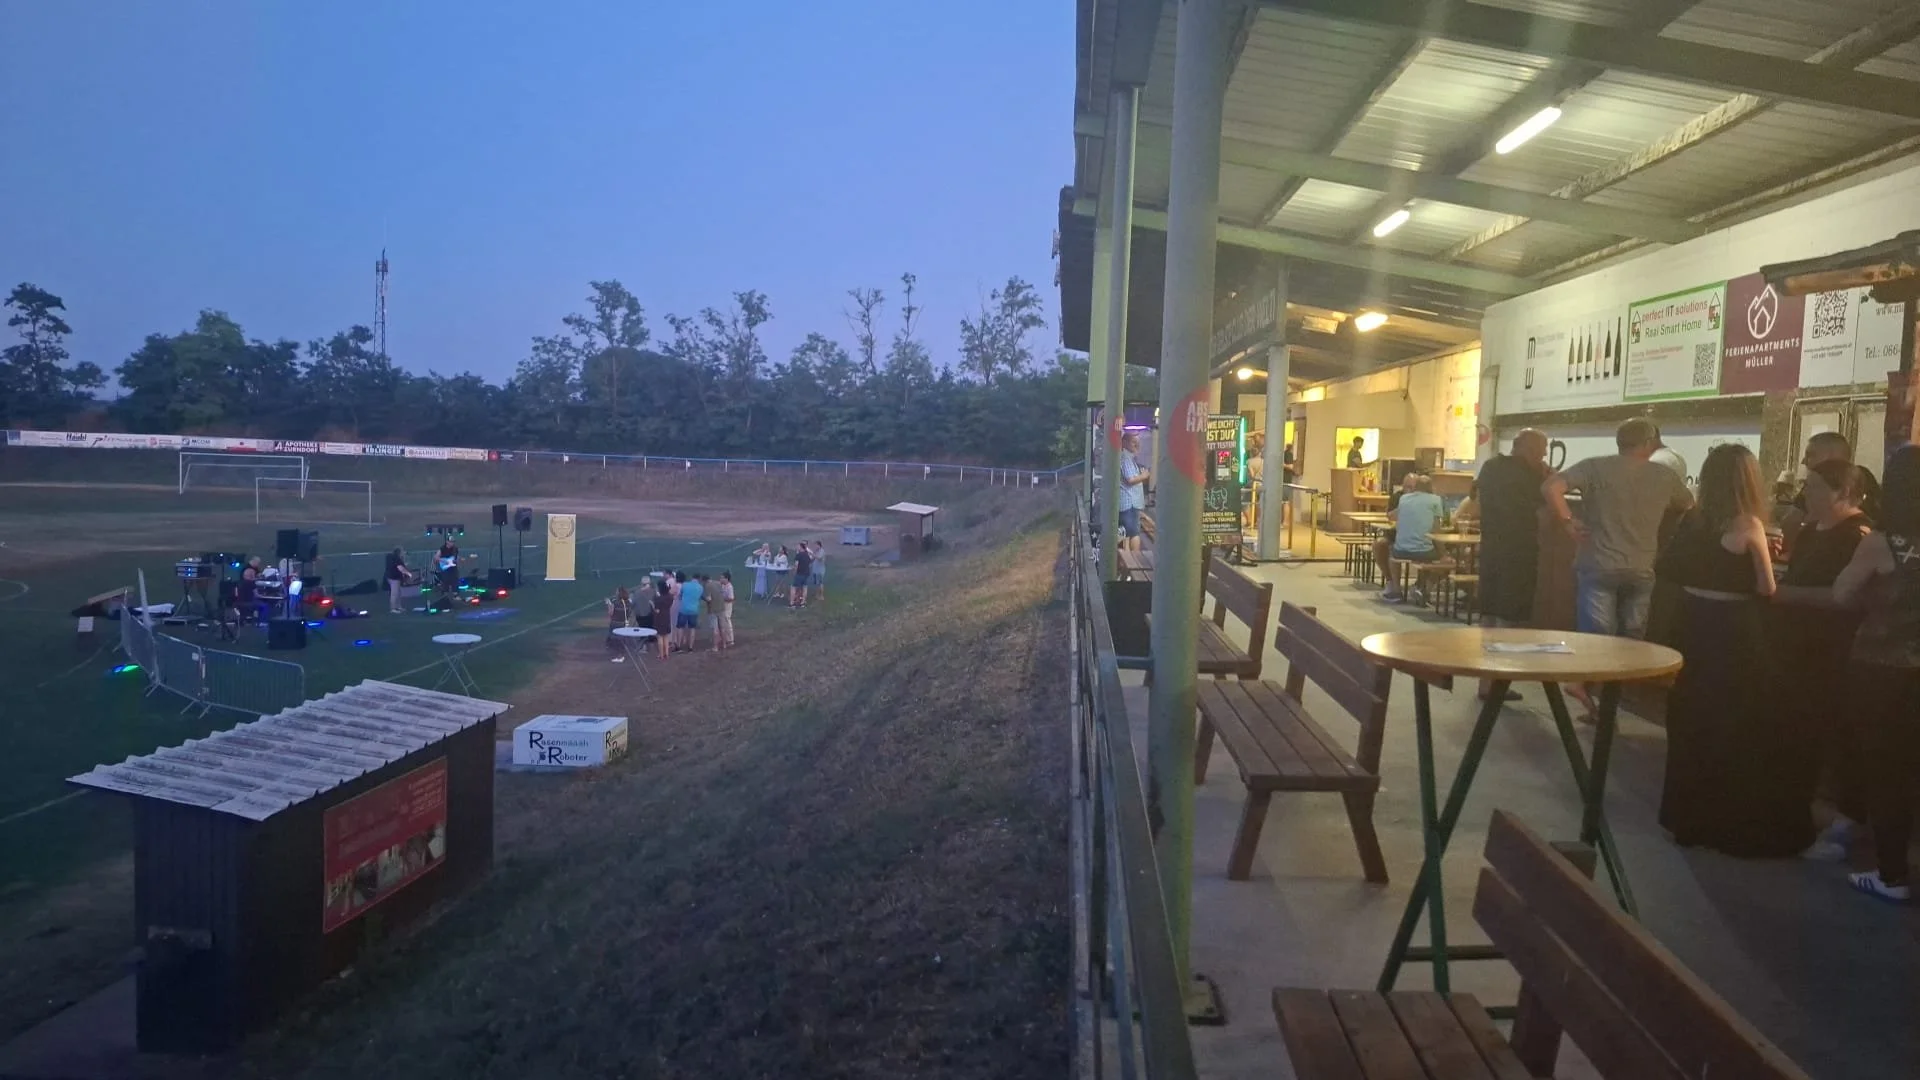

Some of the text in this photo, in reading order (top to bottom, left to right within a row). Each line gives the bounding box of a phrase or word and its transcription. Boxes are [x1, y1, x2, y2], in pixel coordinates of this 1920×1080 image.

[1675, 300, 1708, 315] solutions
[1660, 322, 1680, 336] Smart
[1681, 319, 1702, 333] Home
[1725, 337, 1800, 357] FERIENAPARTMENTS
[1745, 356, 1774, 368] MÜLLER
[1220, 429, 1235, 441] DU?
[548, 746, 588, 764] Roboter
